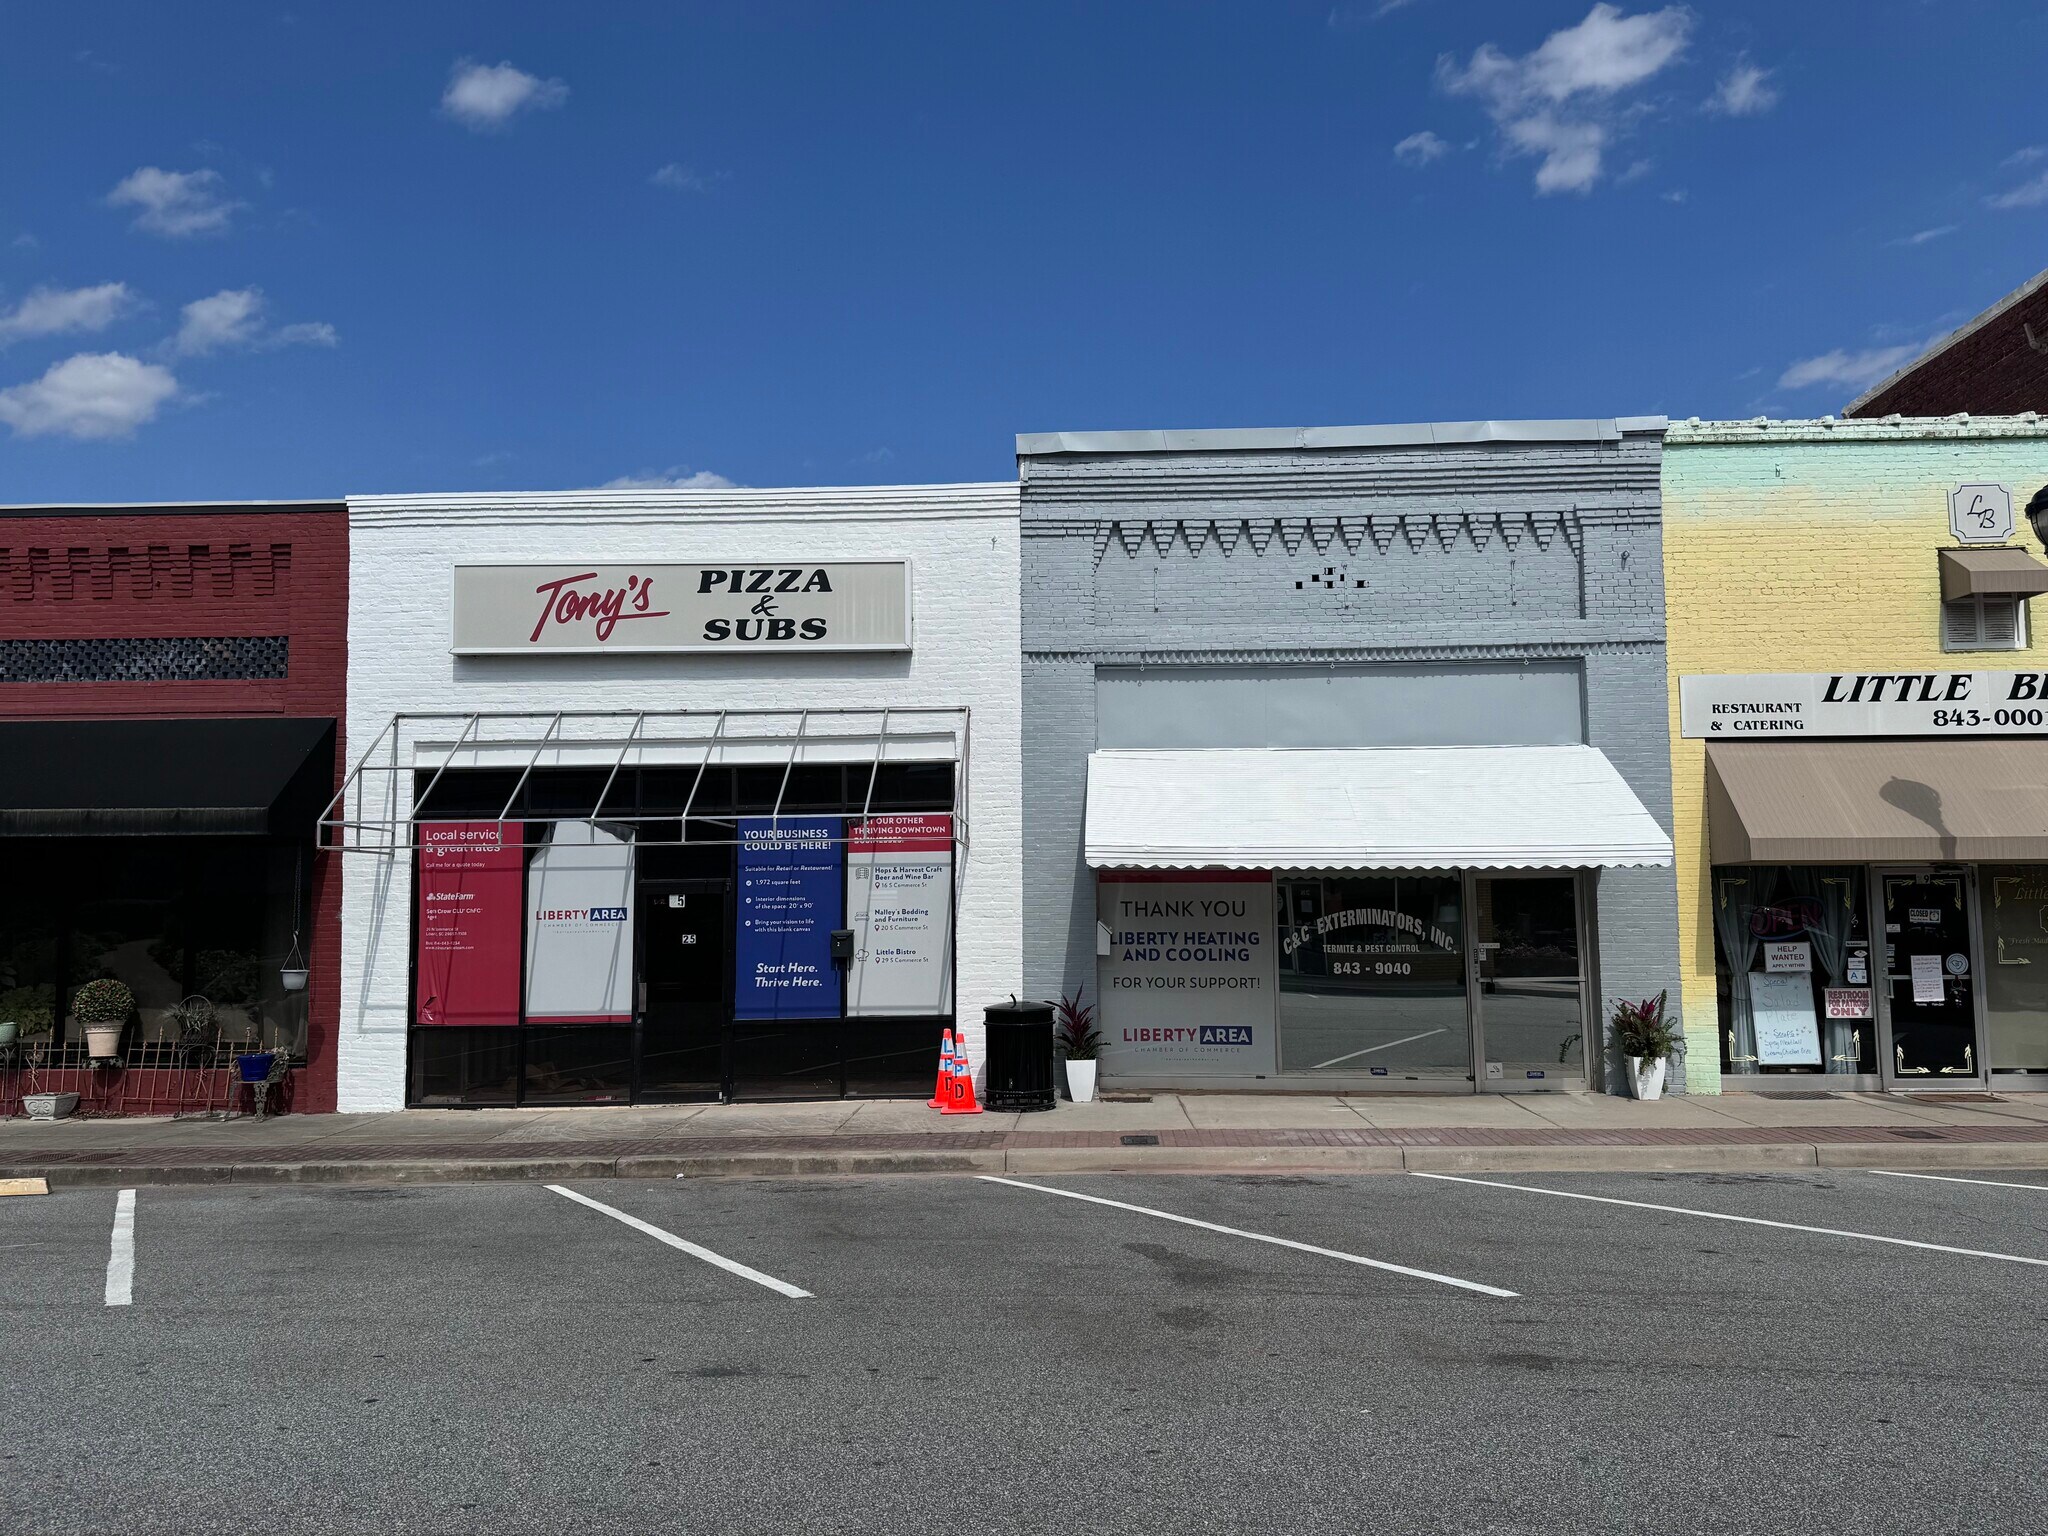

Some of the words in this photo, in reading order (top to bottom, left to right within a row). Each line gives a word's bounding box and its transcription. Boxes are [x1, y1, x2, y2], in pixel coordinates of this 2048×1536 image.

[696, 568, 833, 593] PIZZA
[529, 571, 671, 642] Tony's
[750, 594, 780, 617] &
[702, 617, 828, 641] SUBS
[1821, 674, 1973, 702] LITTLE
[1712, 702, 1802, 714] RESTAURANT
[1932, 708, 2048, 727] 843-000
[1710, 720, 1723, 731] &
[1733, 719, 1804, 731] CATERING
[876, 817, 894, 825] OUR
[426, 829, 457, 841] Local
[459, 828, 503, 840] service
[744, 830, 774, 839] YOUR
[776, 829, 828, 839] BUSINESS
[853, 826, 894, 835] THRIVING
[895, 826, 946, 834] DOWNTOWN
[437, 843, 468, 857] great
[470, 843, 501, 853] rates
[744, 842, 782, 851] COULD
[785, 841, 798, 850] BE
[800, 841, 831, 850] HERE!
[536, 909, 588, 920] LIBERTY
[592, 909, 626, 920] AREA
[875, 909, 900, 917] Nalley's
[901, 908, 929, 916] Bedding
[1120, 900, 1194, 917] THANK
[1200, 900, 1246, 917] YOU
[1910, 909, 1928, 917] CLOSED
[1283, 925, 1310, 955] C&C
[1316, 908, 1426, 941] EXTERMINATORS,
[1430, 925, 1458, 955] INC.
[683, 934, 695, 944] 25
[1110, 931, 1179, 945] LIBERTY
[1184, 931, 1260, 945] HEATING
[1322, 944, 1354, 953] TERMITE
[1356, 945, 1363, 953] &
[1365, 944, 1383, 953] PEST
[1385, 944, 1420, 953] CONTROL
[1122, 948, 1161, 962] AND
[1165, 948, 1250, 962] COOLING
[756, 963, 785, 973] Start
[788, 962, 818, 973] Here.
[1333, 962, 1361, 975] 843
[1375, 962, 1411, 975] 9040
[755, 976, 789, 987] Thrive
[792, 976, 823, 987] Here.
[1113, 977, 1142, 989] FOR
[1146, 977, 1186, 989] YOUR
[1190, 977, 1260, 989] SUPPORT!
[1828, 990, 1869, 999] RESTROOM
[1829, 999, 1840, 1007] FOR
[1842, 999, 1870, 1007] PATRONS
[1830, 1007, 1868, 1016] ONLY
[1123, 1028, 1197, 1042] LIBERTY
[1202, 1028, 1250, 1043] AREA
